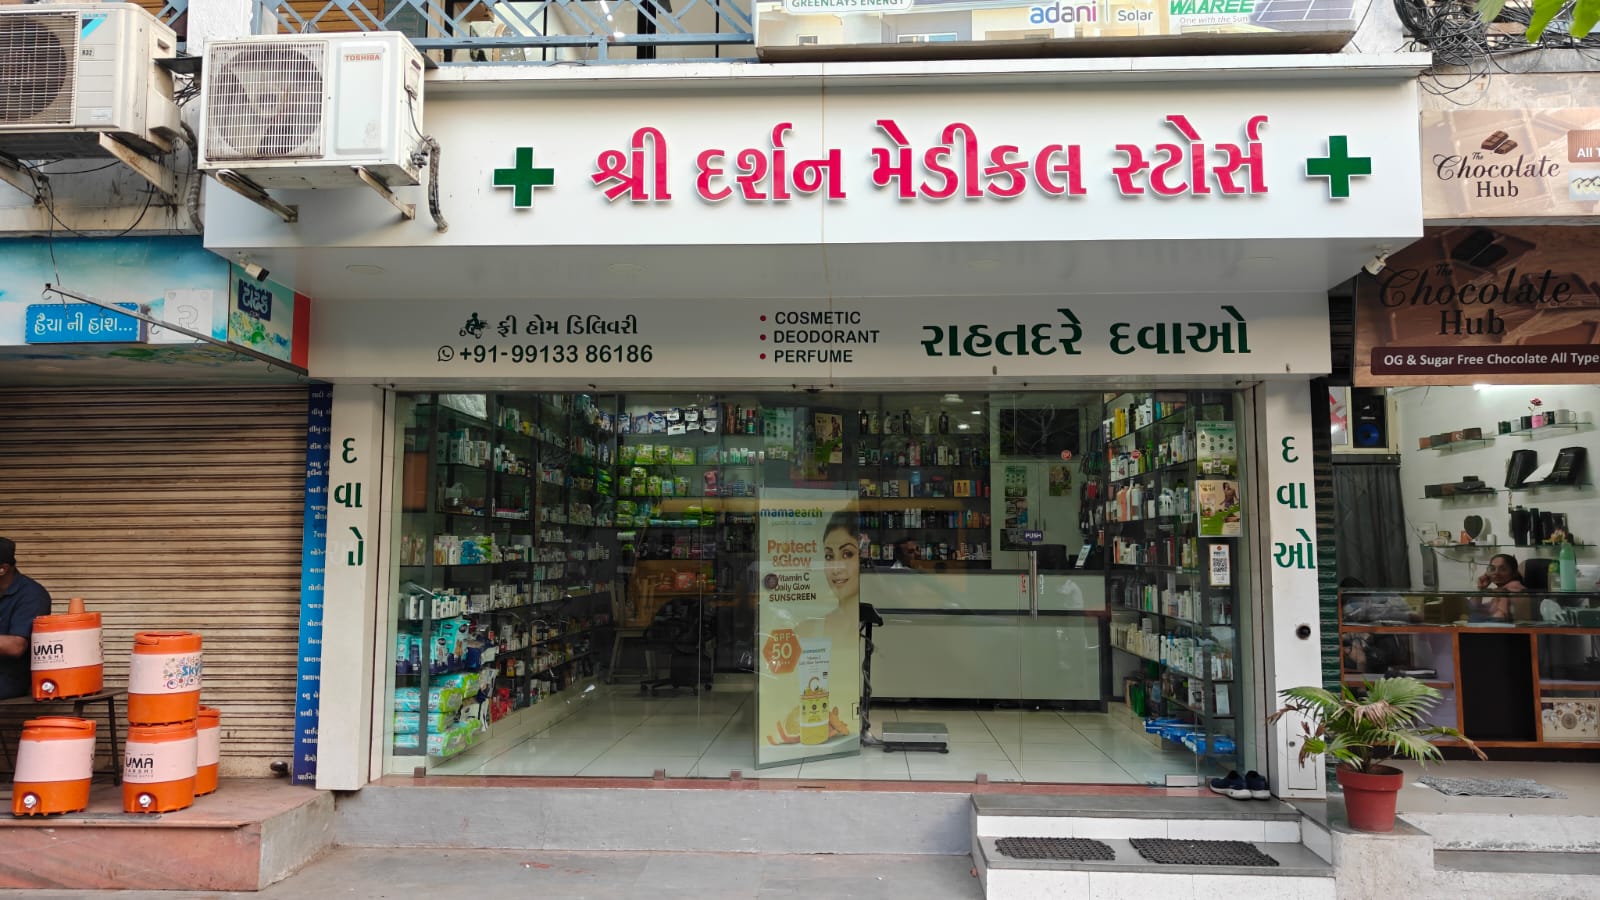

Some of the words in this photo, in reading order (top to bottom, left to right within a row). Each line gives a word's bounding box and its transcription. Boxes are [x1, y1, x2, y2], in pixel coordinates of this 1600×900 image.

[1030, 1, 1097, 24] adani
[1170, 0, 1255, 15] WAAREE
[1118, 9, 1153, 21] Solar
[1179, 16, 1196, 24] One
[1198, 16, 1215, 24] with
[1217, 16, 1231, 24] the
[590, 126, 673, 202] શ્રી
[695, 121, 847, 201] દર્શન
[869, 118, 1087, 201] મેડીકલ
[1111, 113, 1269, 197] સ્ટોર્સ
[1472, 152, 1484, 160] The
[1576, 147, 1592, 158] All
[1432, 154, 1560, 181] Chocolate
[1476, 180, 1519, 198] Hub
[1436, 263, 1453, 277] The
[1377, 268, 1573, 307] Chocolate
[67, 311, 83, 332] ની
[526, 314, 559, 335] હોમ
[566, 314, 638, 335] ડિલિવરી
[775, 311, 861, 324] COSMETIC
[1438, 309, 1505, 336] Hub
[773, 330, 880, 343] DEODORANT
[920, 308, 1083, 357] રાહતદરે
[1109, 305, 1252, 355] દવાઓ
[459, 344, 579, 363] +91-99133
[585, 344, 653, 363] 86186
[774, 349, 853, 363] PERFUME
[1383, 354, 1403, 366] OG
[1406, 354, 1417, 366] &
[1420, 354, 1454, 368] Sugar
[1457, 353, 1484, 365] Free
[1486, 352, 1548, 365] Chocolate
[1550, 352, 1567, 363] All
[1570, 352, 1600, 366] Type
[760, 507, 823, 518] mamaearth
[767, 539, 817, 554] Protect
[804, 573, 810, 581] C
[792, 582, 811, 591] Glow
[769, 592, 817, 602] SUNSCREEN
[33, 643, 63, 655] UMA
[772, 643, 793, 660] 50
[126, 757, 154, 769] UMA
